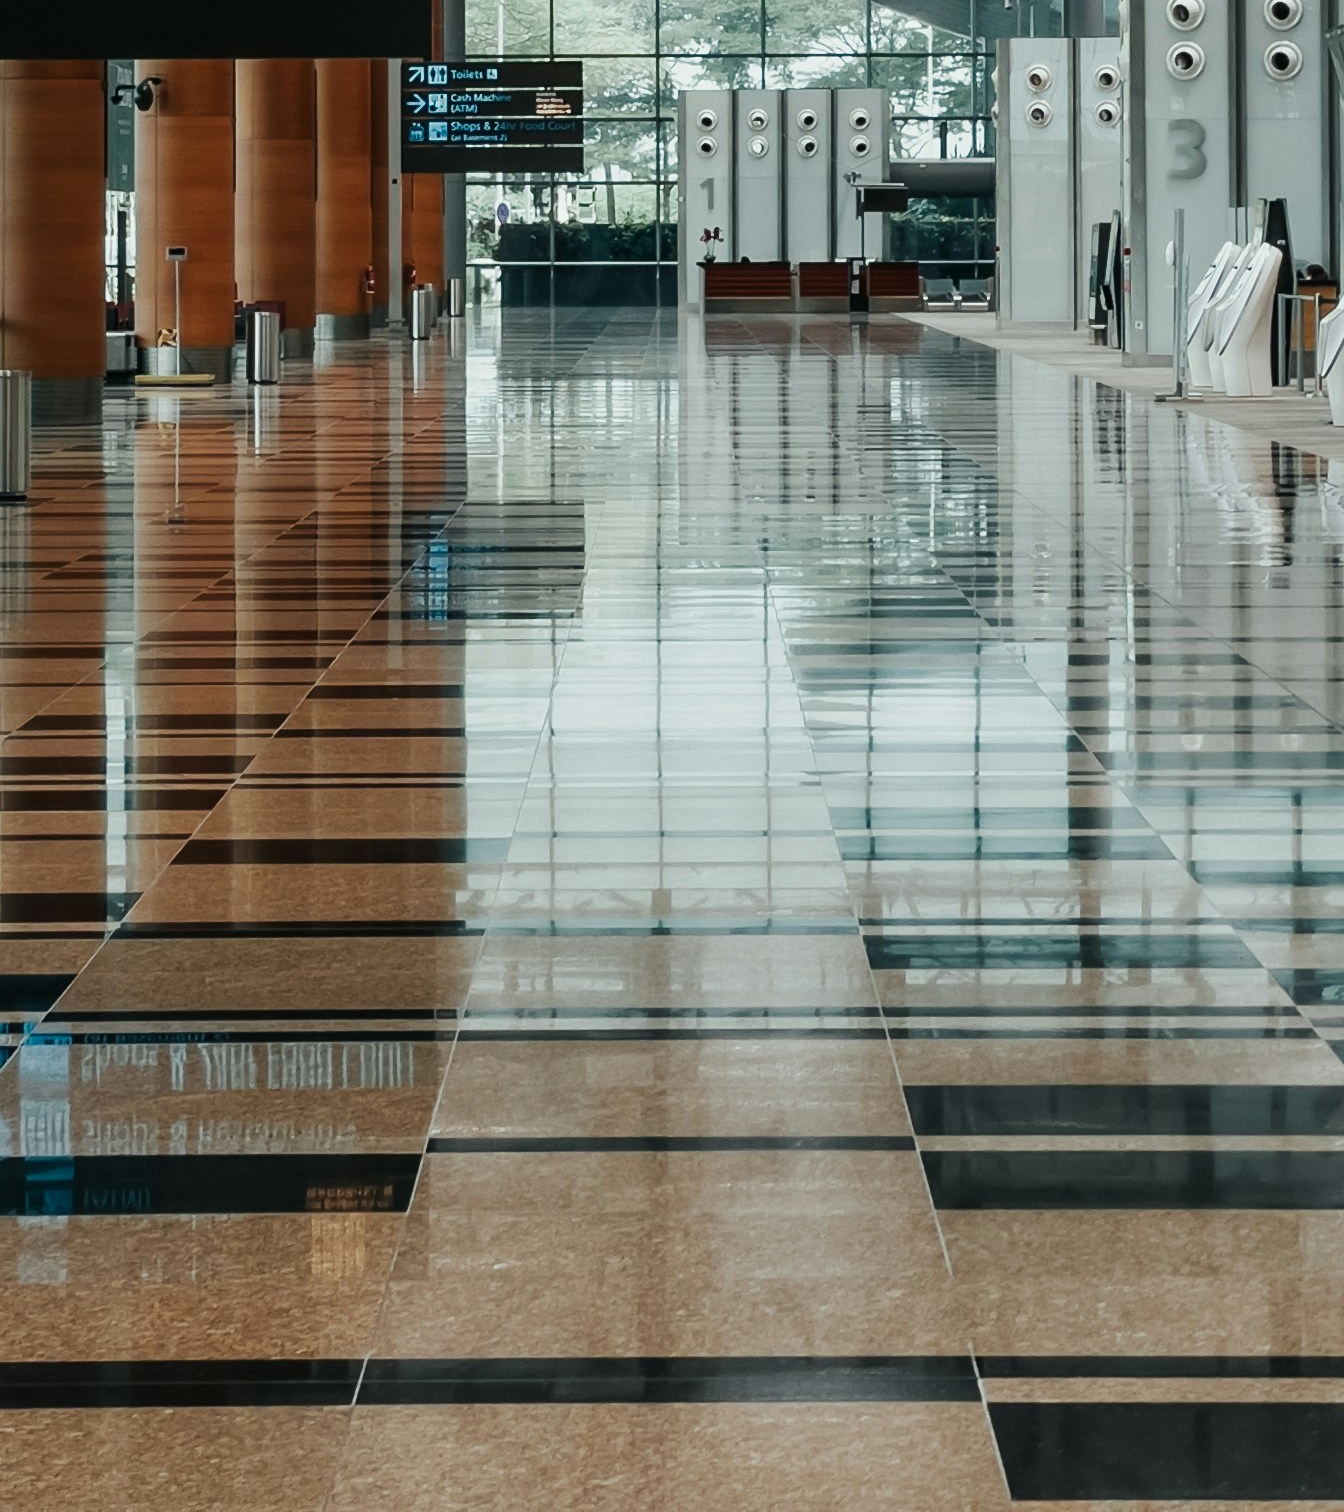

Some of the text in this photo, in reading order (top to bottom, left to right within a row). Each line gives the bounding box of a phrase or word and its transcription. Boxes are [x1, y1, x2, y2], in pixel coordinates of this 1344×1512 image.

[450, 69, 483, 80] Toilets
[450, 93, 512, 102] Cash Machine
[450, 104, 478, 114] (ATM)
[450, 121, 481, 132] Shops
[484, 122, 491, 131] &
[1167, 118, 1207, 179] 3
[700, 178, 714, 209] 1
